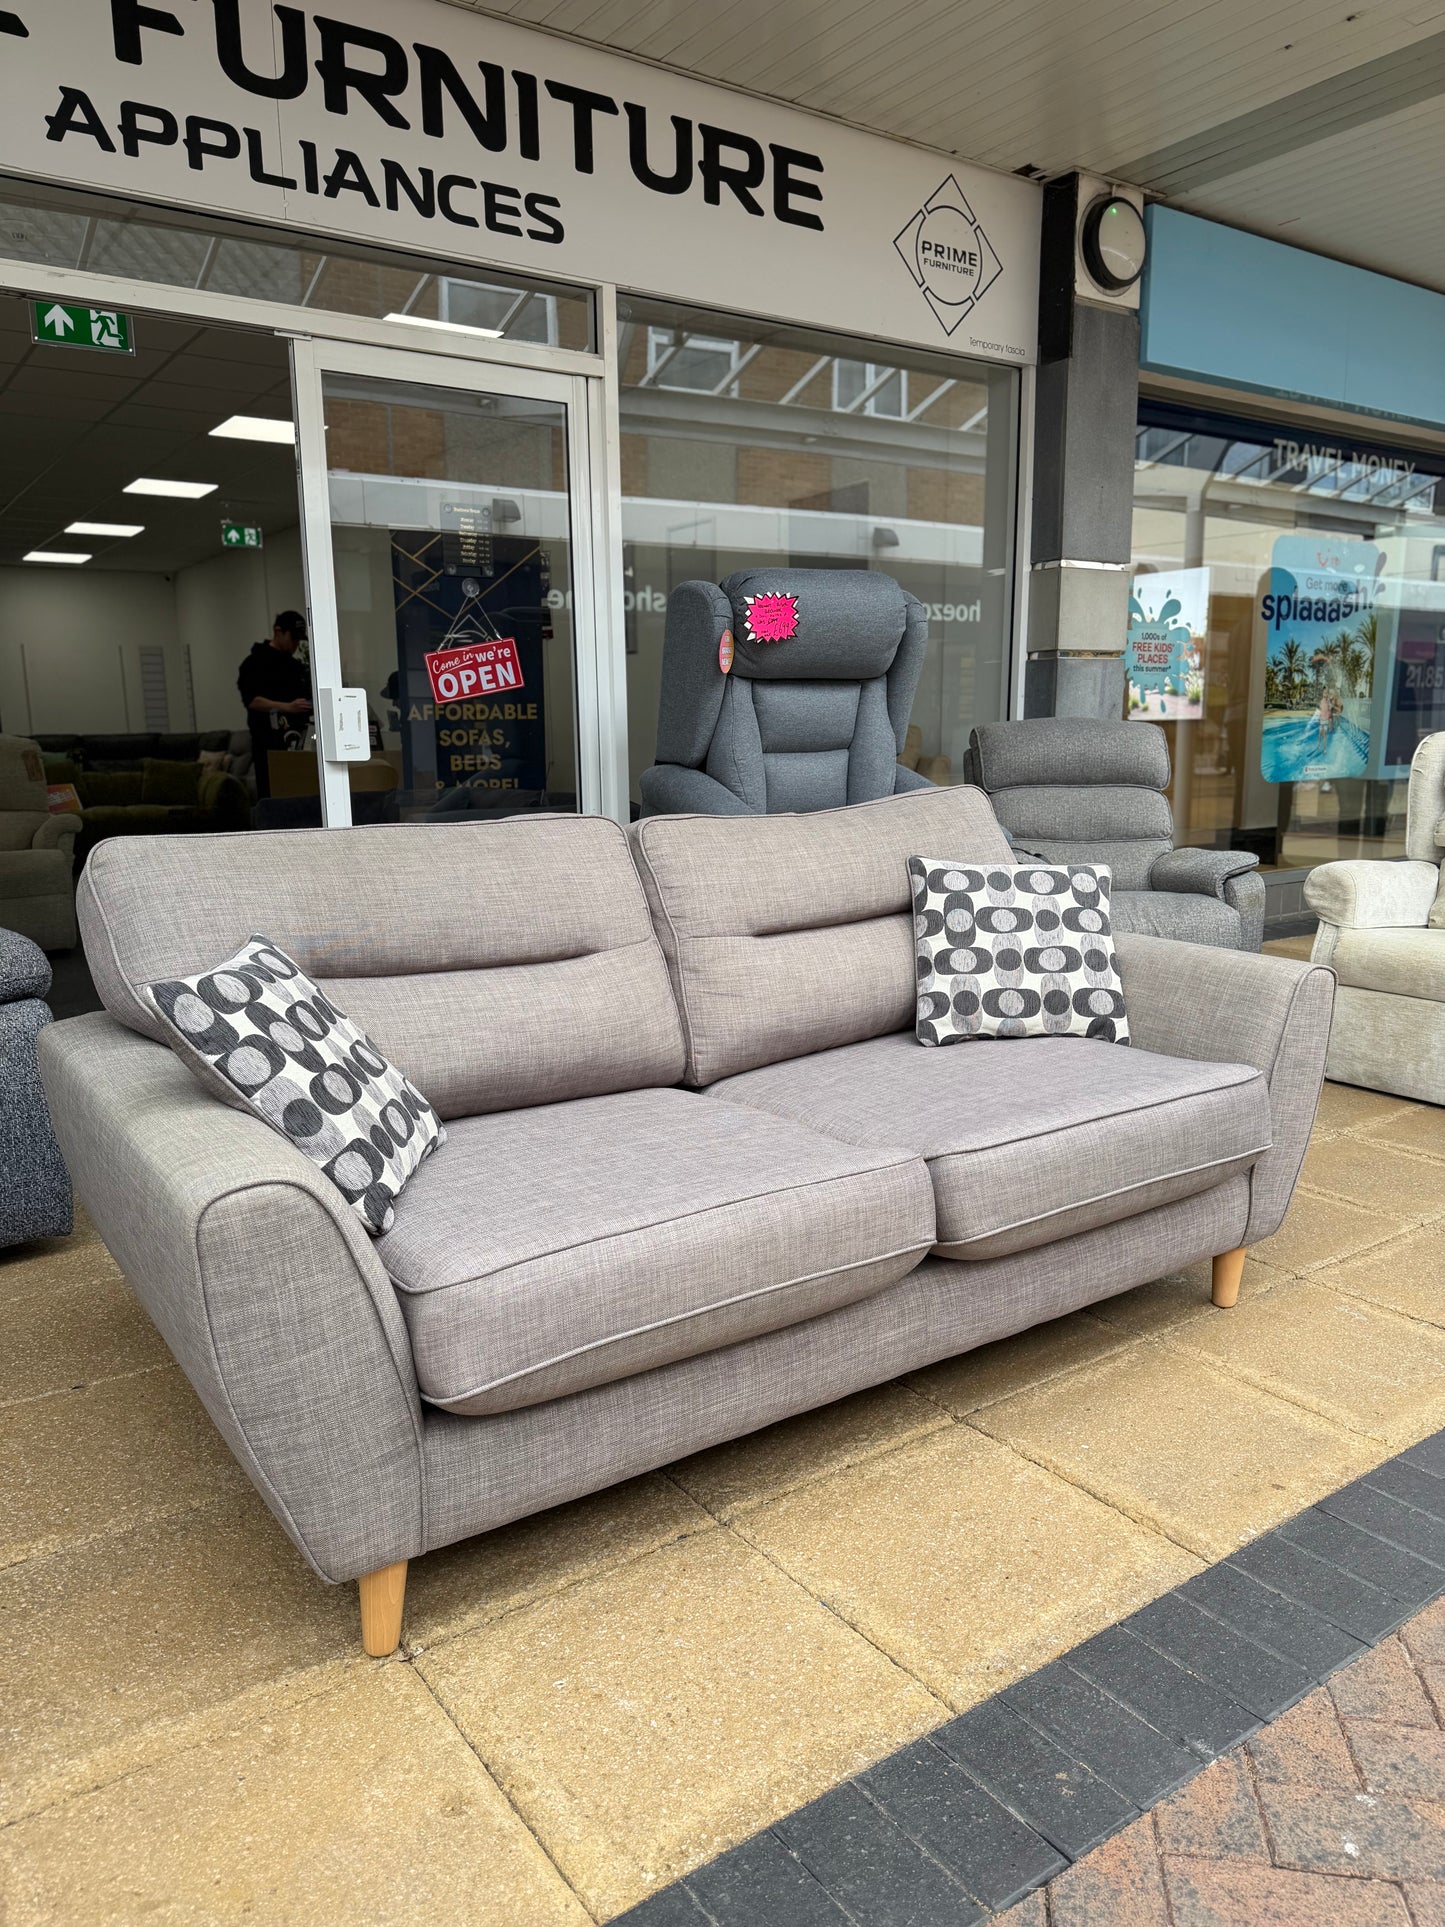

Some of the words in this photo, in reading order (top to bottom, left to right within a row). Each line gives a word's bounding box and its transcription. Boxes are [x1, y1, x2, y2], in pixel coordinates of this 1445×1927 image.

[111, 0, 824, 232] FURNITURE
[45, 85, 565, 244] APPLIANCES
[921, 240, 978, 268] PRIME
[923, 258, 975, 277] FURNITURE
[969, 336, 1004, 354] Temporary
[1006, 344, 1026, 356] fascia
[1273, 438, 1346, 478] TRAVEL
[1352, 452, 1415, 486] MONEY
[1305, 577, 1323, 590] Get
[1324, 581, 1348, 595] more
[1141, 632, 1160, 641] 1,000s
[1161, 632, 1168, 641] of
[1132, 641, 1153, 653] FREE
[432, 656, 461, 675] Come
[463, 650, 475, 664] in
[475, 645, 512, 663] we're
[1133, 664, 1145, 673] this
[1137, 653, 1169, 665] PLACES
[438, 661, 517, 698] OPEN
[407, 702, 539, 721] AFFORDABLE
[439, 728, 512, 749] SOFAS,
[450, 753, 503, 772] BEDS
